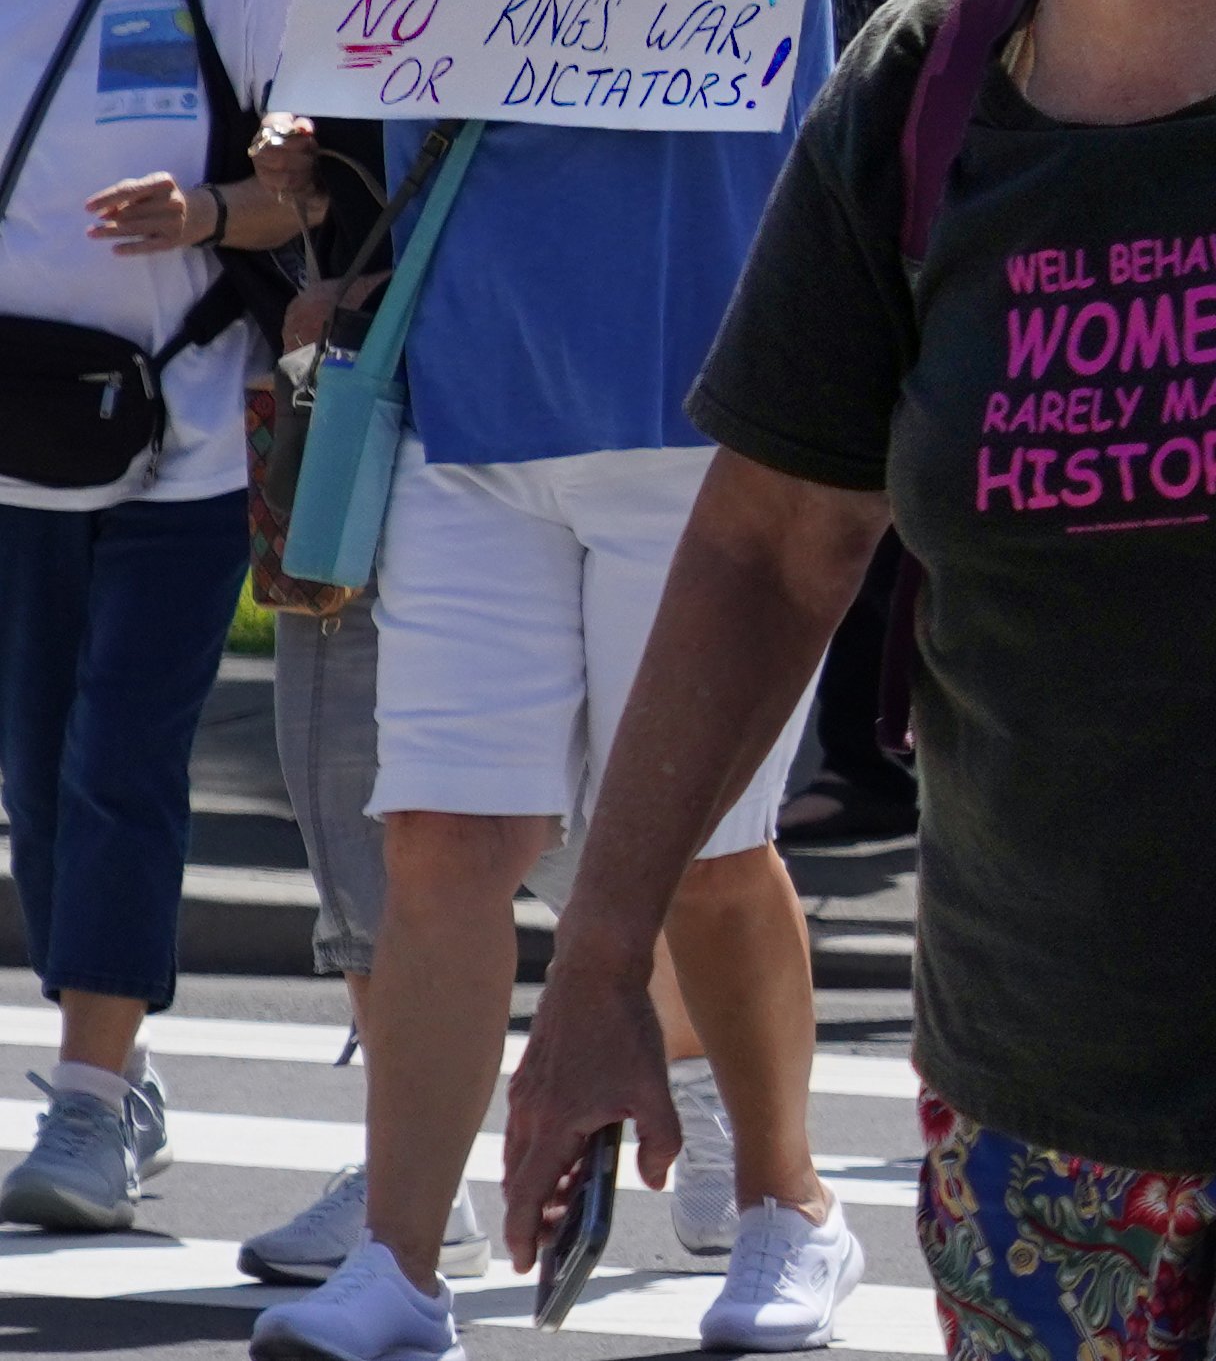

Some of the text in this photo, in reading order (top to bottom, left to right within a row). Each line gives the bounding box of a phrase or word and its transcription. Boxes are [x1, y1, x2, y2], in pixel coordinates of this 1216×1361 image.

[646, 0, 761, 64] WAR,
[380, 55, 454, 106] OR
[1007, 248, 1096, 295] WELL
[982, 386, 1146, 435] RARELY
